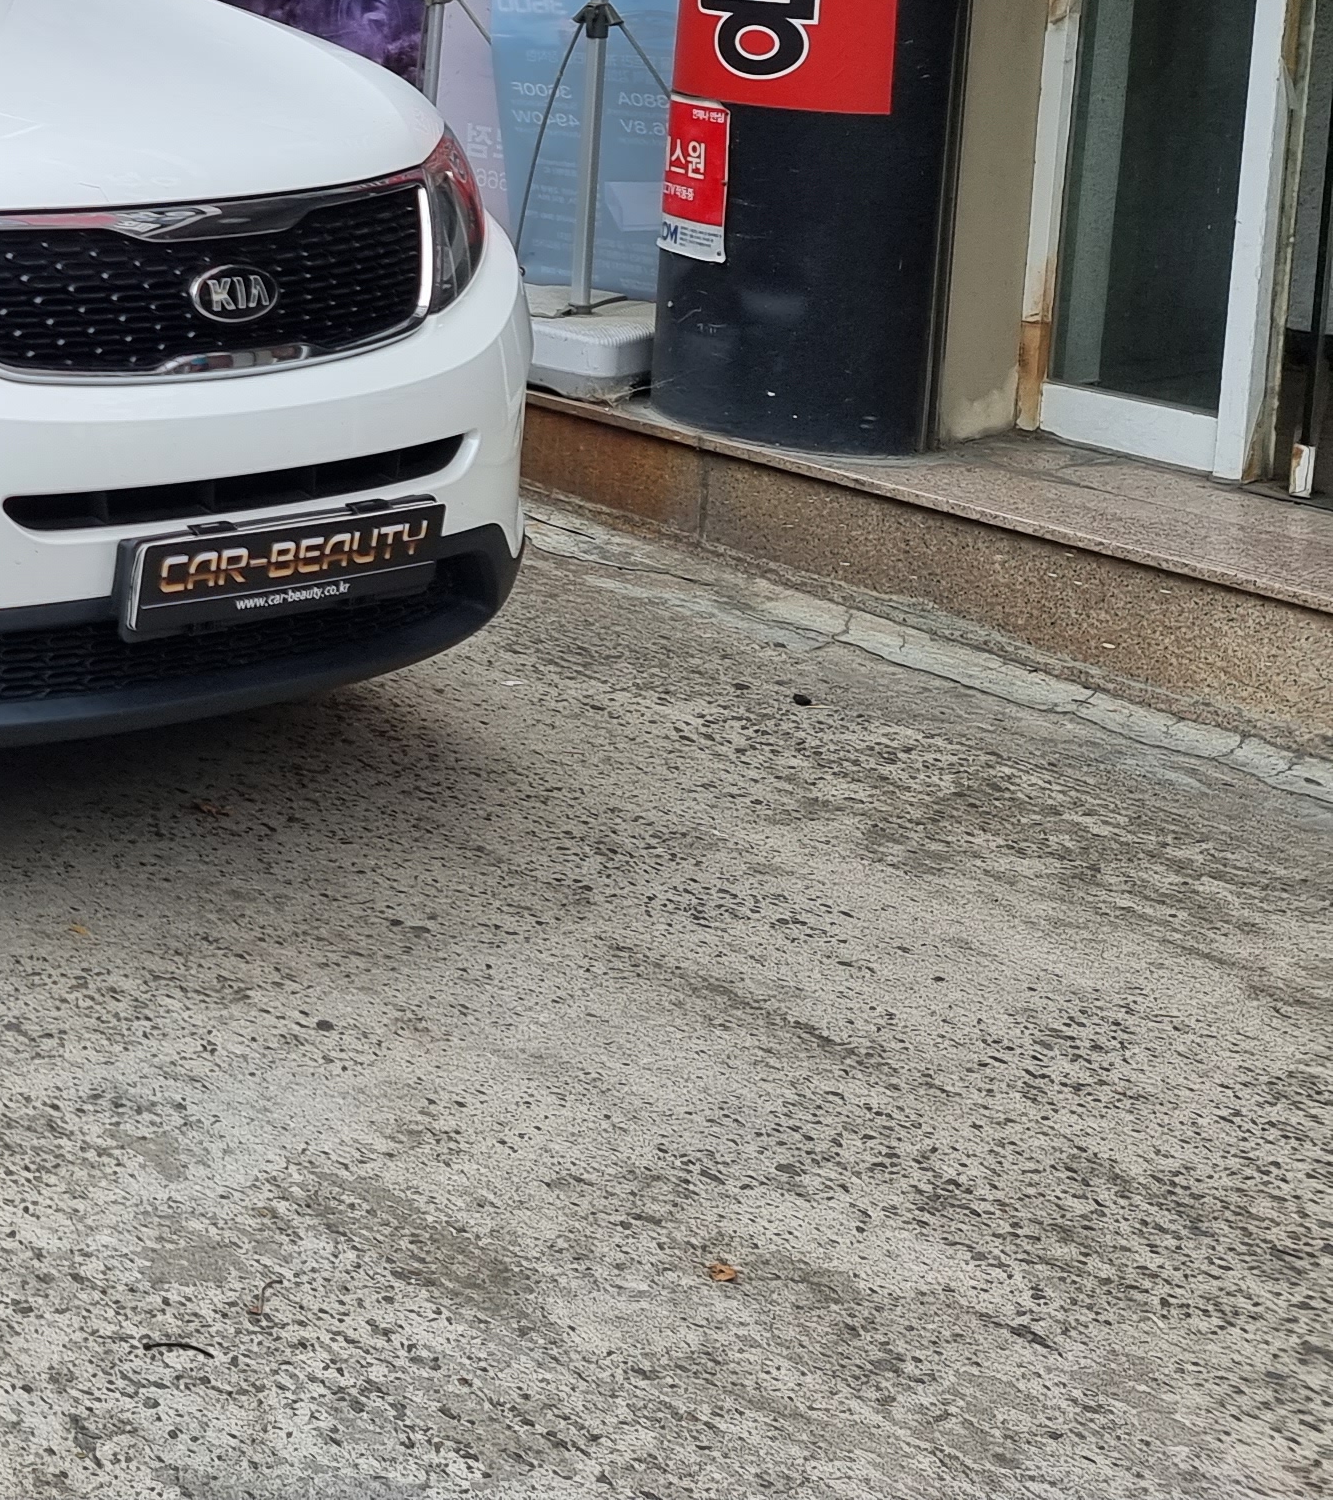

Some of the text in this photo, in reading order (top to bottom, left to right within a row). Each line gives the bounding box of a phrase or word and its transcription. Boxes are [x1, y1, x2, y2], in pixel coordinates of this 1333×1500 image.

[209, 274, 270, 311] KIA
[158, 520, 428, 594] CAR-BEAUTY
[235, 580, 351, 611] www.car-beauty.co.kr
